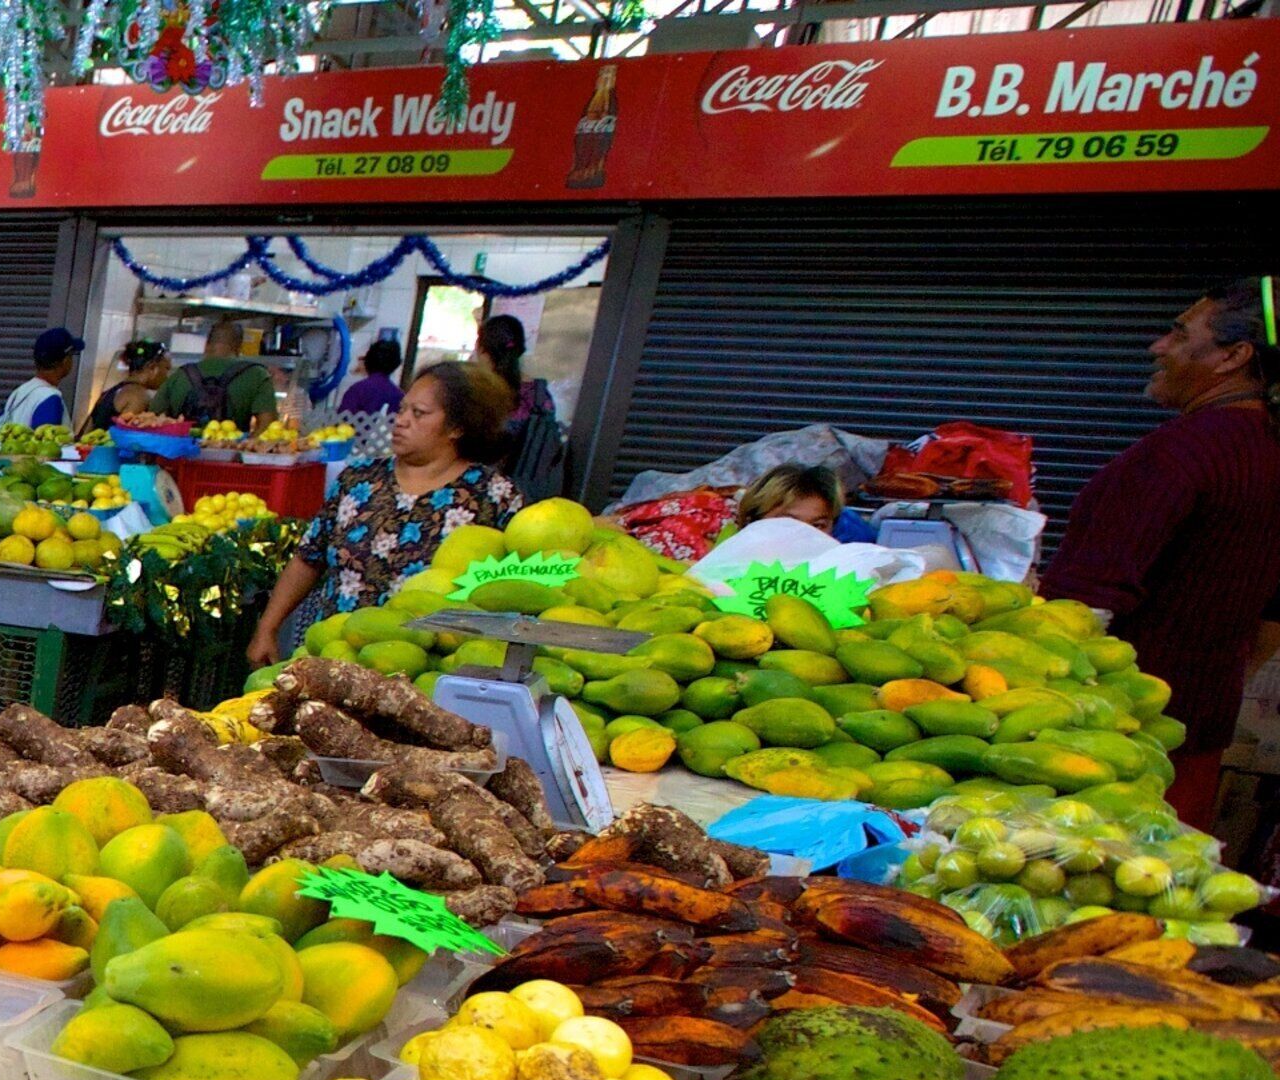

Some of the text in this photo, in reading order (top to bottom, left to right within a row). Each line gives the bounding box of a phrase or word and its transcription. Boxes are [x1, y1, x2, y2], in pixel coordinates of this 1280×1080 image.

[700, 58, 886, 115] Coca-Cola
[934, 51, 1259, 118] B.B. Marché
[99, 91, 224, 138] Coca-Cola
[279, 96, 382, 142] Snack
[315, 153, 450, 176] Tél. 27 08 09
[977, 132, 1179, 163] Tél. 79 06 59
